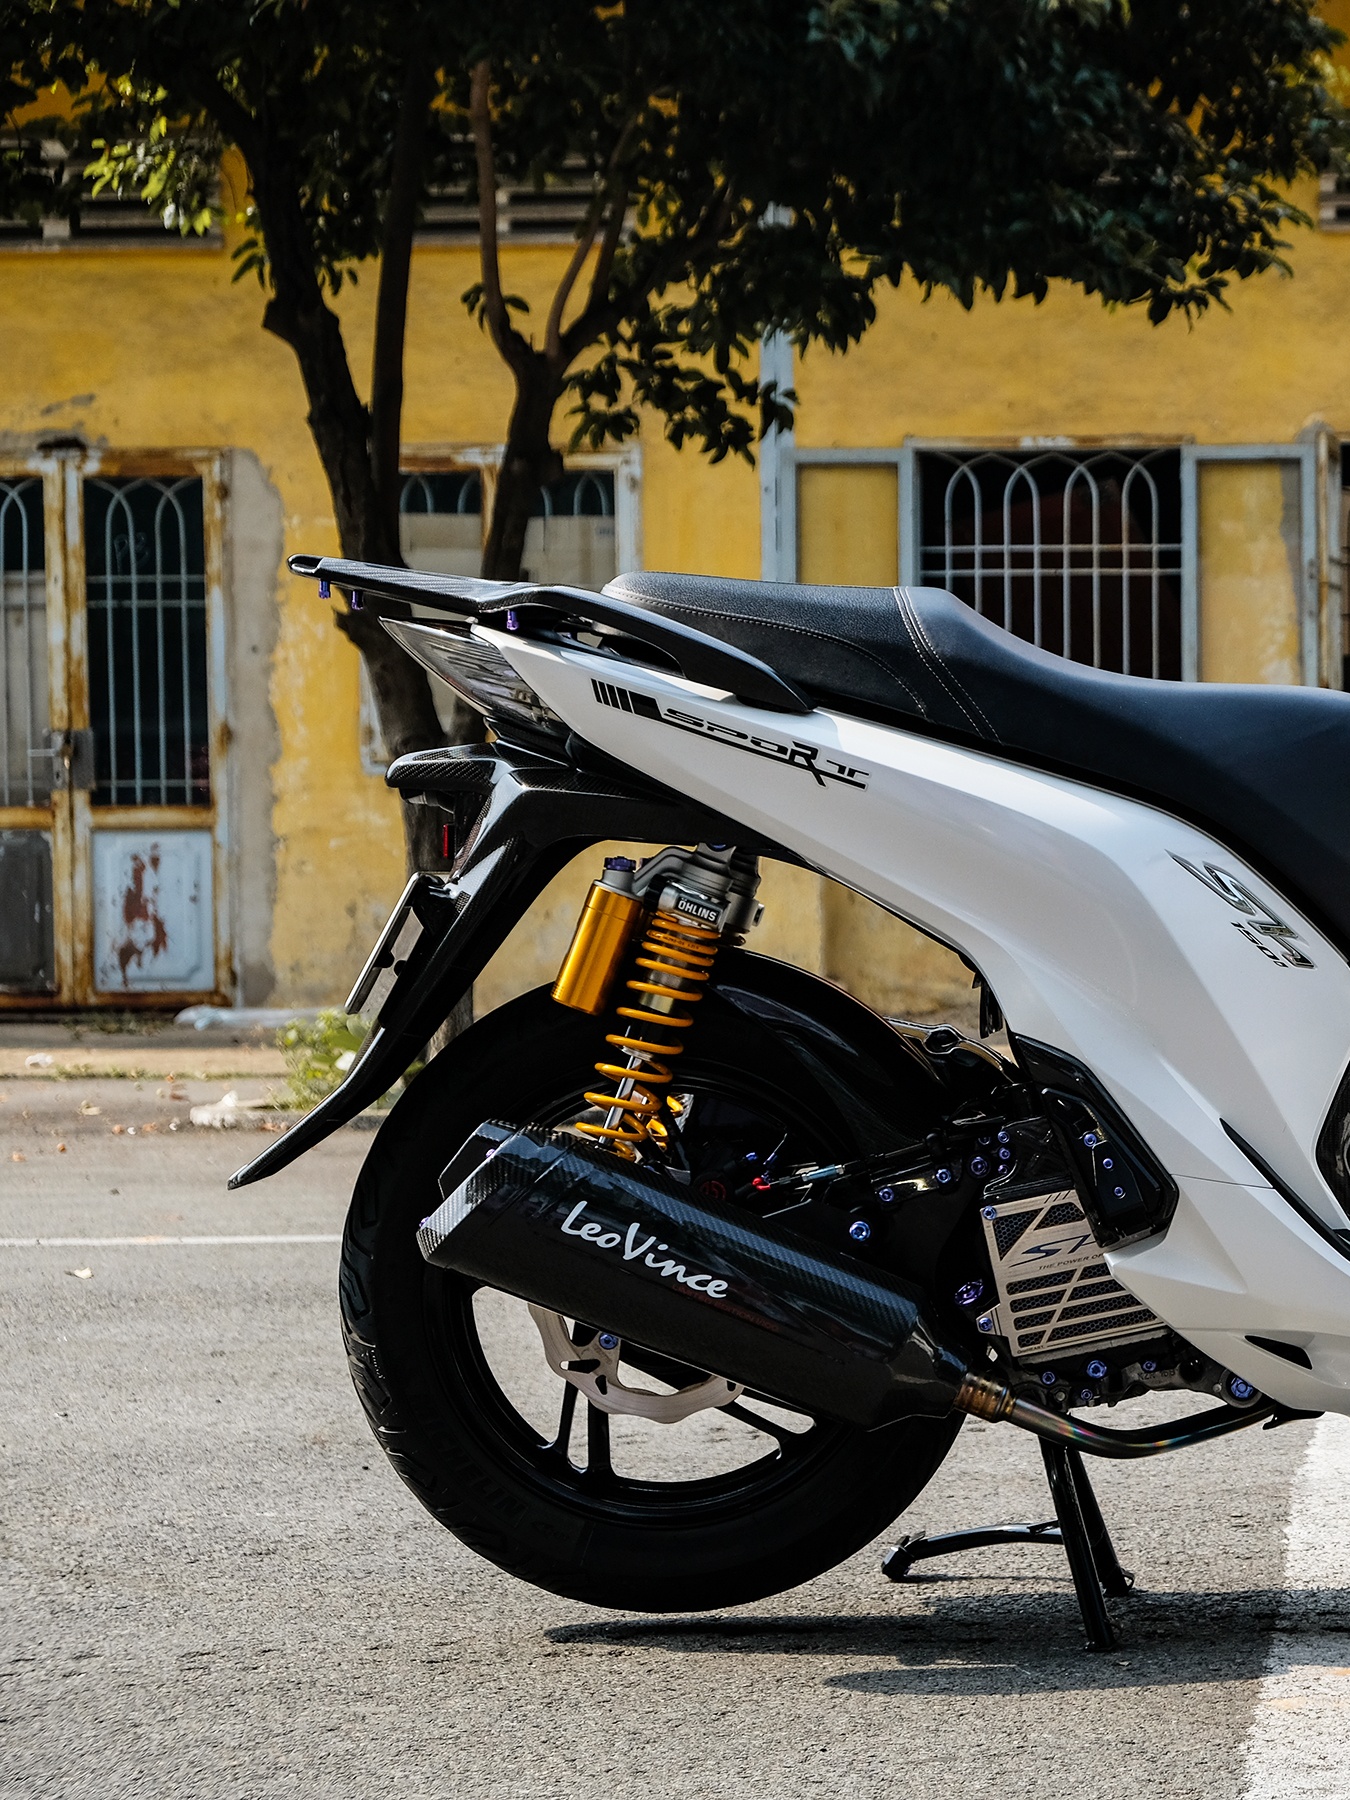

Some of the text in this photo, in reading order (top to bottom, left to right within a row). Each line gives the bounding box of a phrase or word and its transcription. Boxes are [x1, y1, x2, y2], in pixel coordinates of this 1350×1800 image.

[677, 898, 718, 922] ÖHLINS
[560, 1200, 730, 1299] LeoVince
[1056, 1255, 1090, 1267] POWER
